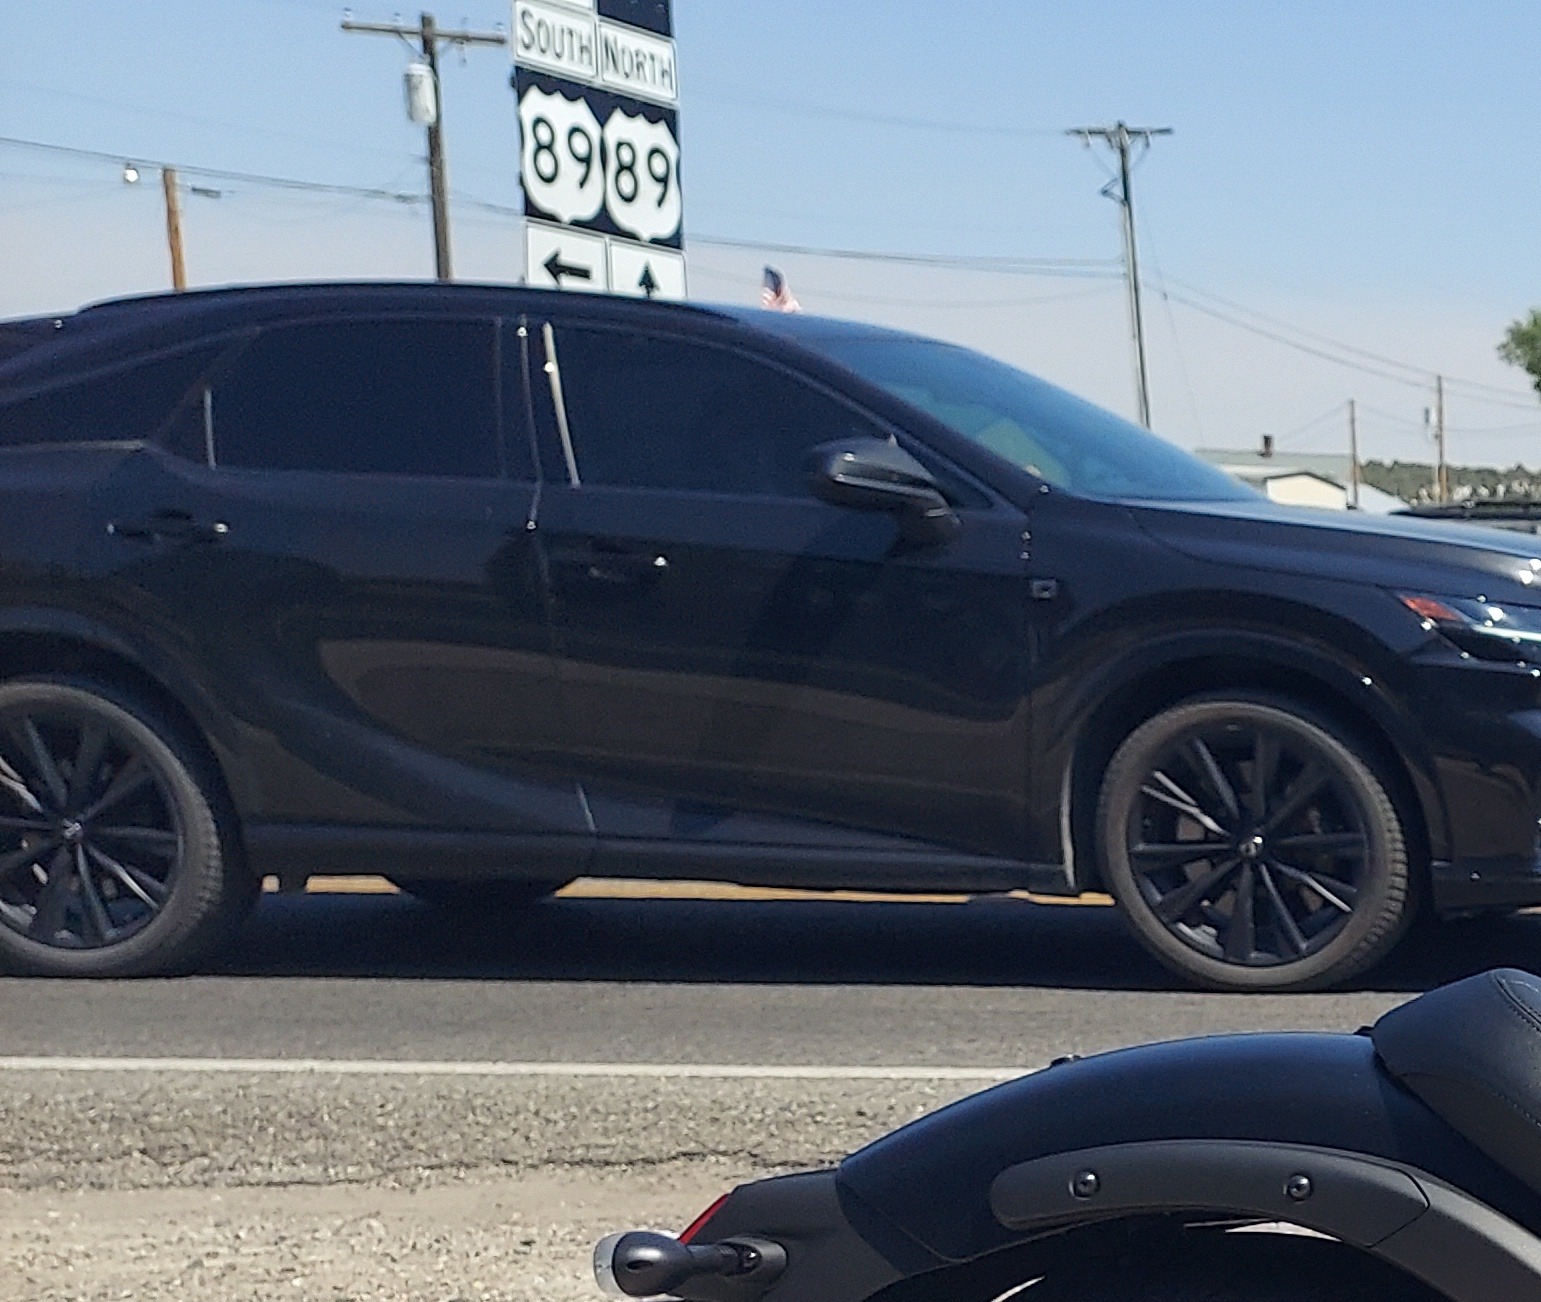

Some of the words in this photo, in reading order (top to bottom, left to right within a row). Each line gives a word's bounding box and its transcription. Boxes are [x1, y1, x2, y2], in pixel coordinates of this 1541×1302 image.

[520, 9, 593, 68] SOUTH
[604, 34, 674, 91] NORTH
[532, 117, 593, 189] 89
[615, 141, 670, 209] 89
